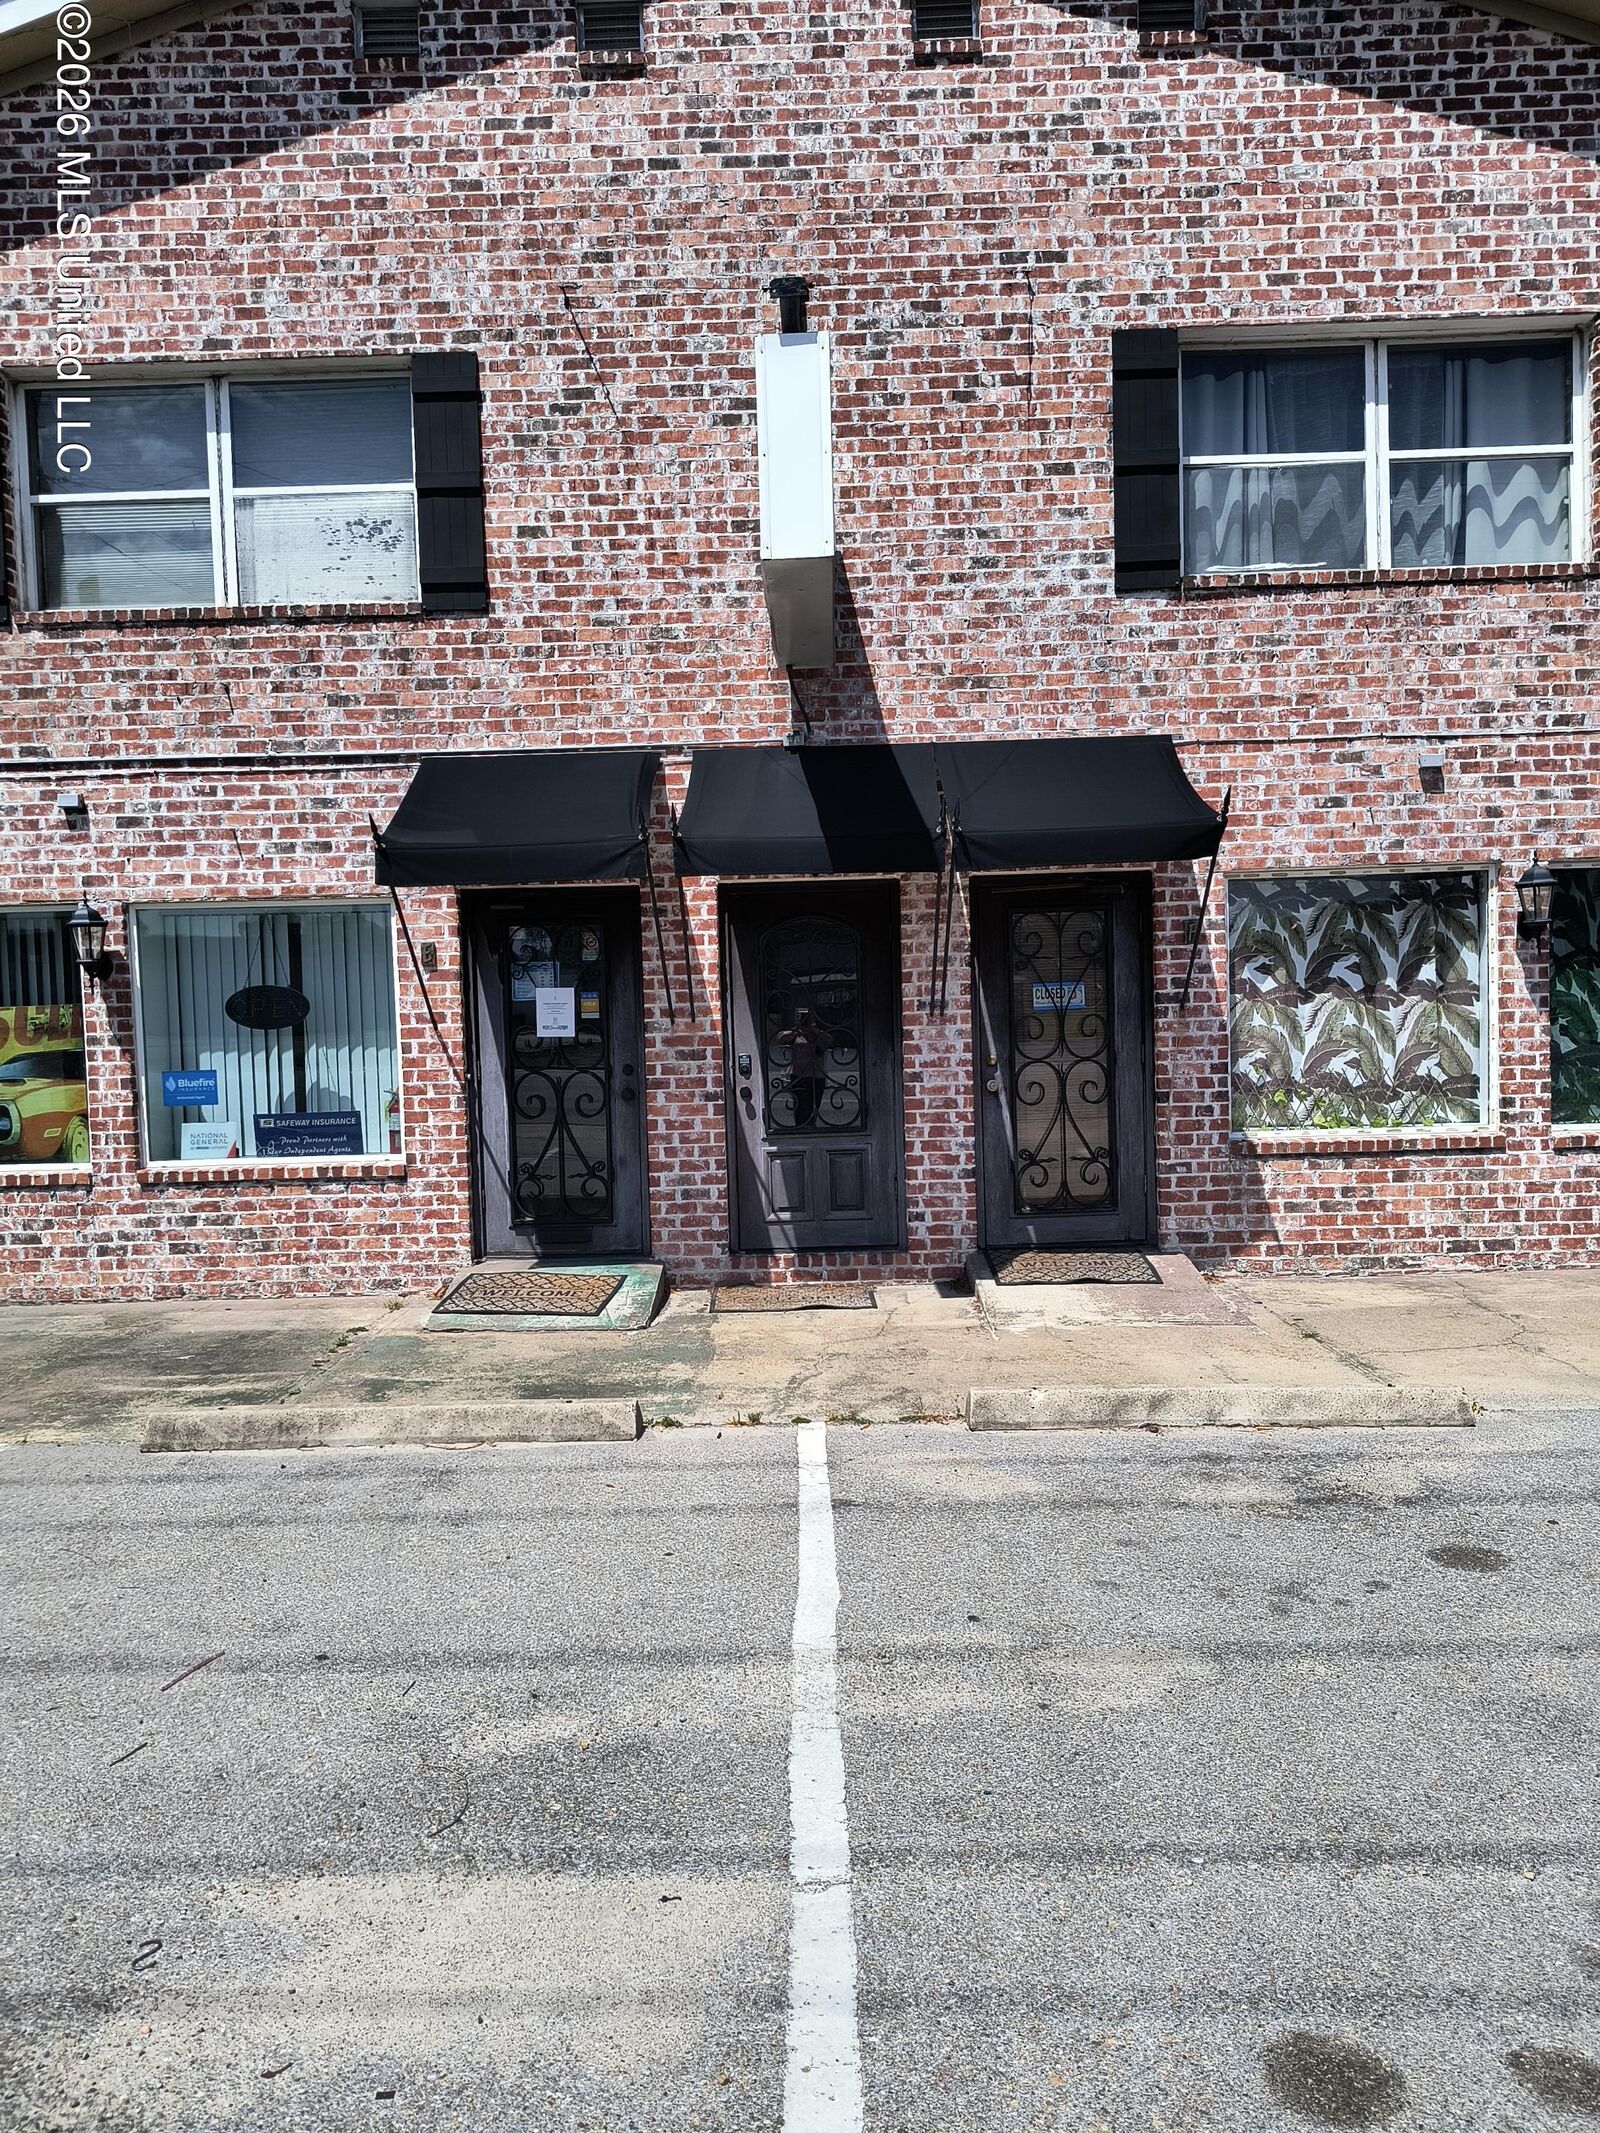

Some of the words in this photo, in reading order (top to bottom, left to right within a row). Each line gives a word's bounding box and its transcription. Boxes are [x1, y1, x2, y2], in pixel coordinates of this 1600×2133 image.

[1035, 988, 1066, 1000] CLOSED
[178, 1078, 215, 1088] Bluefire
[276, 1119, 310, 1127] SAFEWAY
[312, 1117, 356, 1126] INSURANCE
[301, 1135, 331, 1144] Partners
[332, 1134, 347, 1142] with
[283, 1146, 326, 1155] Independent
[1020, 1260, 1120, 1268] WELCOME
[482, 1289, 584, 1297] WELCOME
